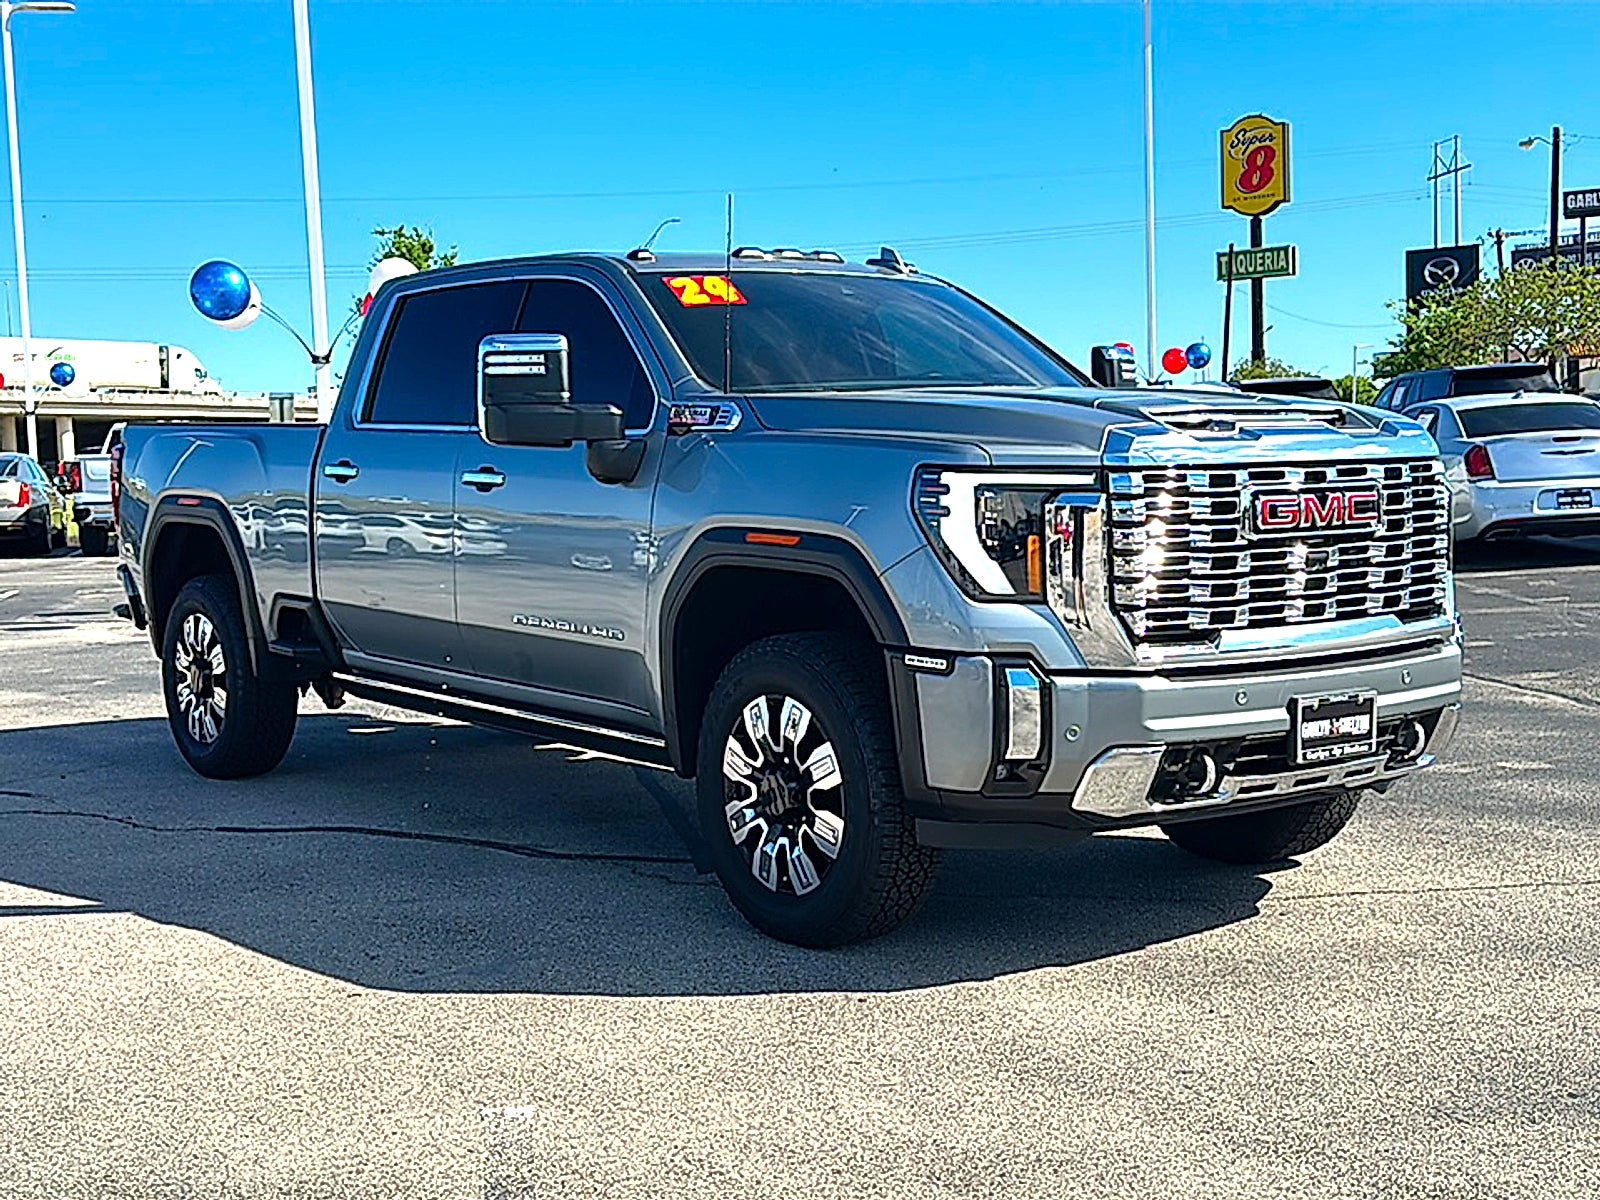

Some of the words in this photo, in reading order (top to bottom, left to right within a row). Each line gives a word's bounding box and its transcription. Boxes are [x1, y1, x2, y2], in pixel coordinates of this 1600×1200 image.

[1229, 127, 1276, 158] Super
[1235, 145, 1276, 194] 8
[1566, 192, 1600, 210] GARL
[1257, 489, 1378, 530] GMC
